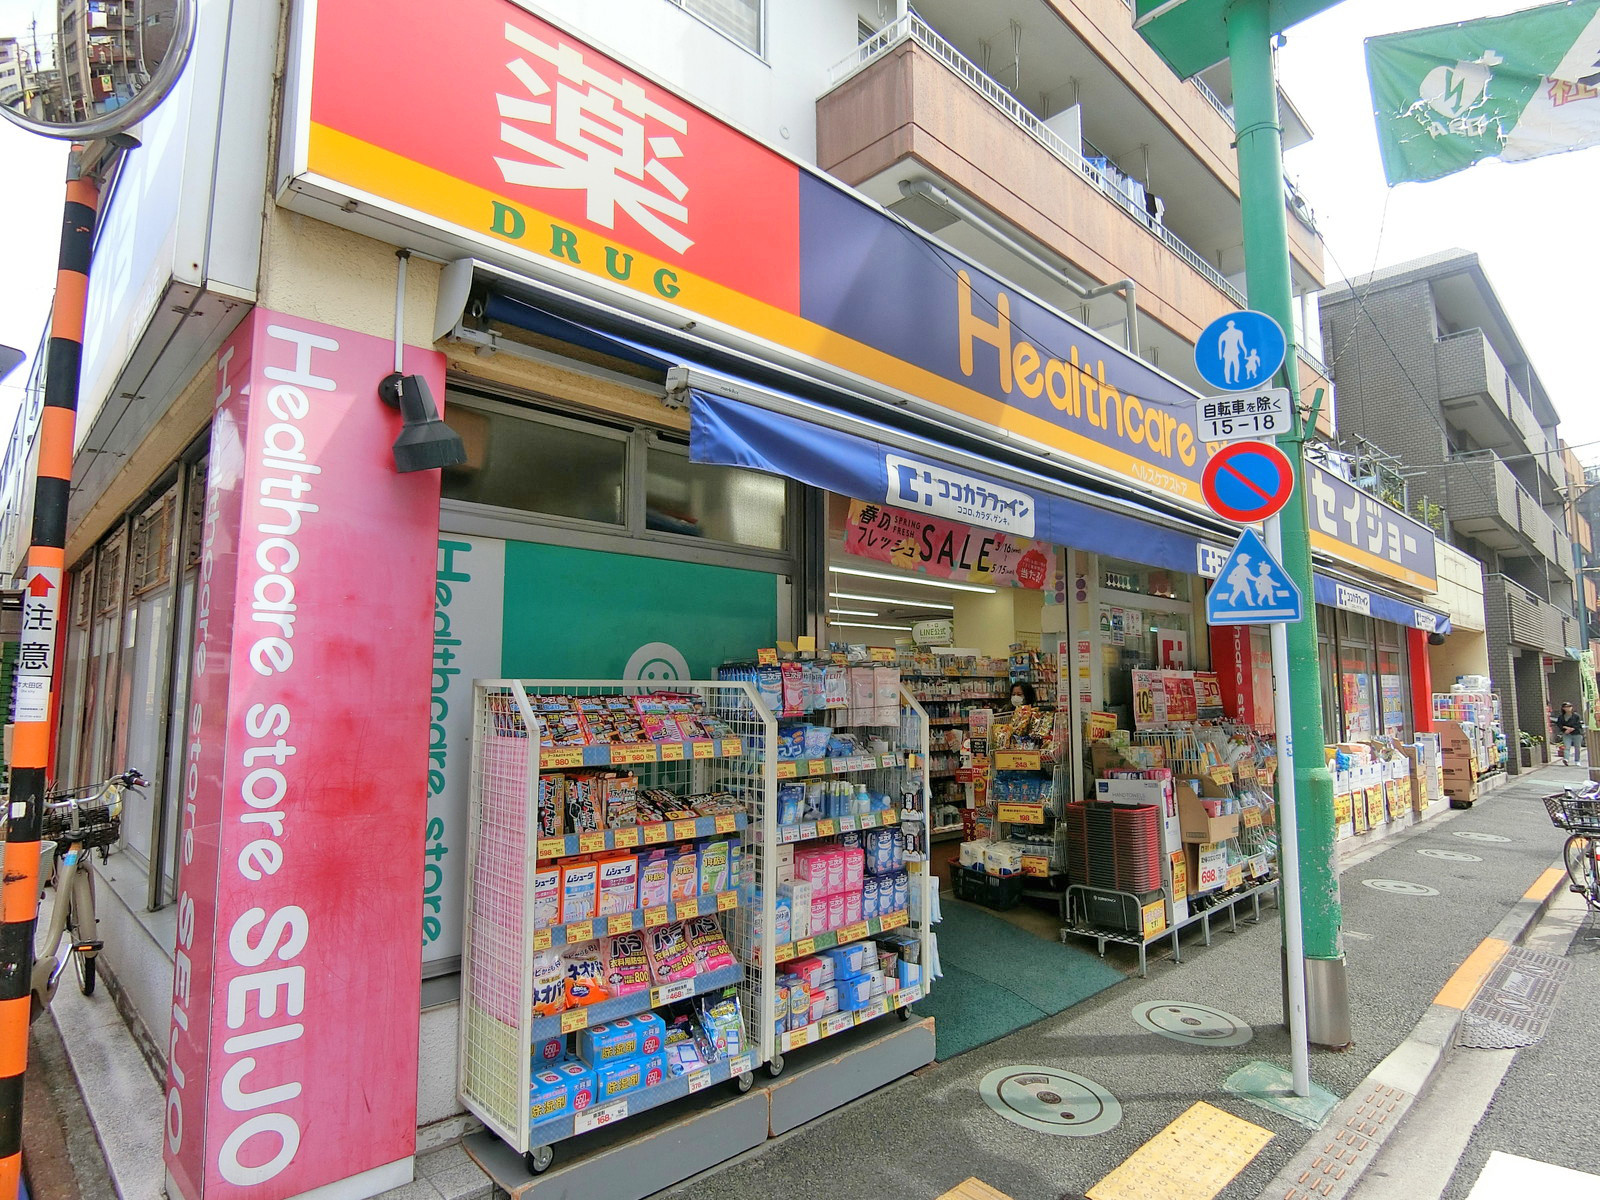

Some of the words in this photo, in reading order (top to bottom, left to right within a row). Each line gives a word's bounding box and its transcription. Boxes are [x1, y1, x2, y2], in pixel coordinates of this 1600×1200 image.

[493, 22, 693, 255] 薬
[490, 200, 682, 299] DRUG
[958, 270, 1197, 467] Healthcare
[1203, 396, 1281, 419] 自転車を除く
[1212, 414, 1275, 436] 15-18
[1131, 461, 1188, 496] ヘルスケアストア
[196, 345, 234, 678] Healthcare
[249, 322, 340, 677] Healthcare
[937, 478, 1029, 518] ココカラファイン
[860, 504, 890, 532] 春の
[893, 515, 921, 530] SPRING
[1311, 468, 1417, 564] セイジョー
[857, 526, 915, 559] フレッシュ
[892, 526, 915, 539] FRESH
[919, 524, 996, 573] SALE
[20, 603, 54, 670] 注意
[427, 539, 472, 800] Healthcare
[183, 702, 204, 868] store
[237, 703, 297, 882] store
[422, 816, 449, 948] store
[535, 875, 558, 887] シューダ
[567, 871, 595, 883] ムシューダ
[606, 865, 632, 876] ムシューダ
[1202, 868, 1216, 884] 698
[653, 922, 682, 951] パラ
[691, 918, 717, 938] パラ
[612, 935, 642, 958] パラ
[670, 991, 682, 999] 468
[164, 896, 196, 1155] SEIJO
[218, 905, 309, 1187] SEIJO
[602, 1041, 636, 1059] 除湿剤
[607, 1074, 640, 1094] 除湿剤
[531, 1095, 566, 1118] 除湿剤
[597, 1114, 610, 1124] 168
